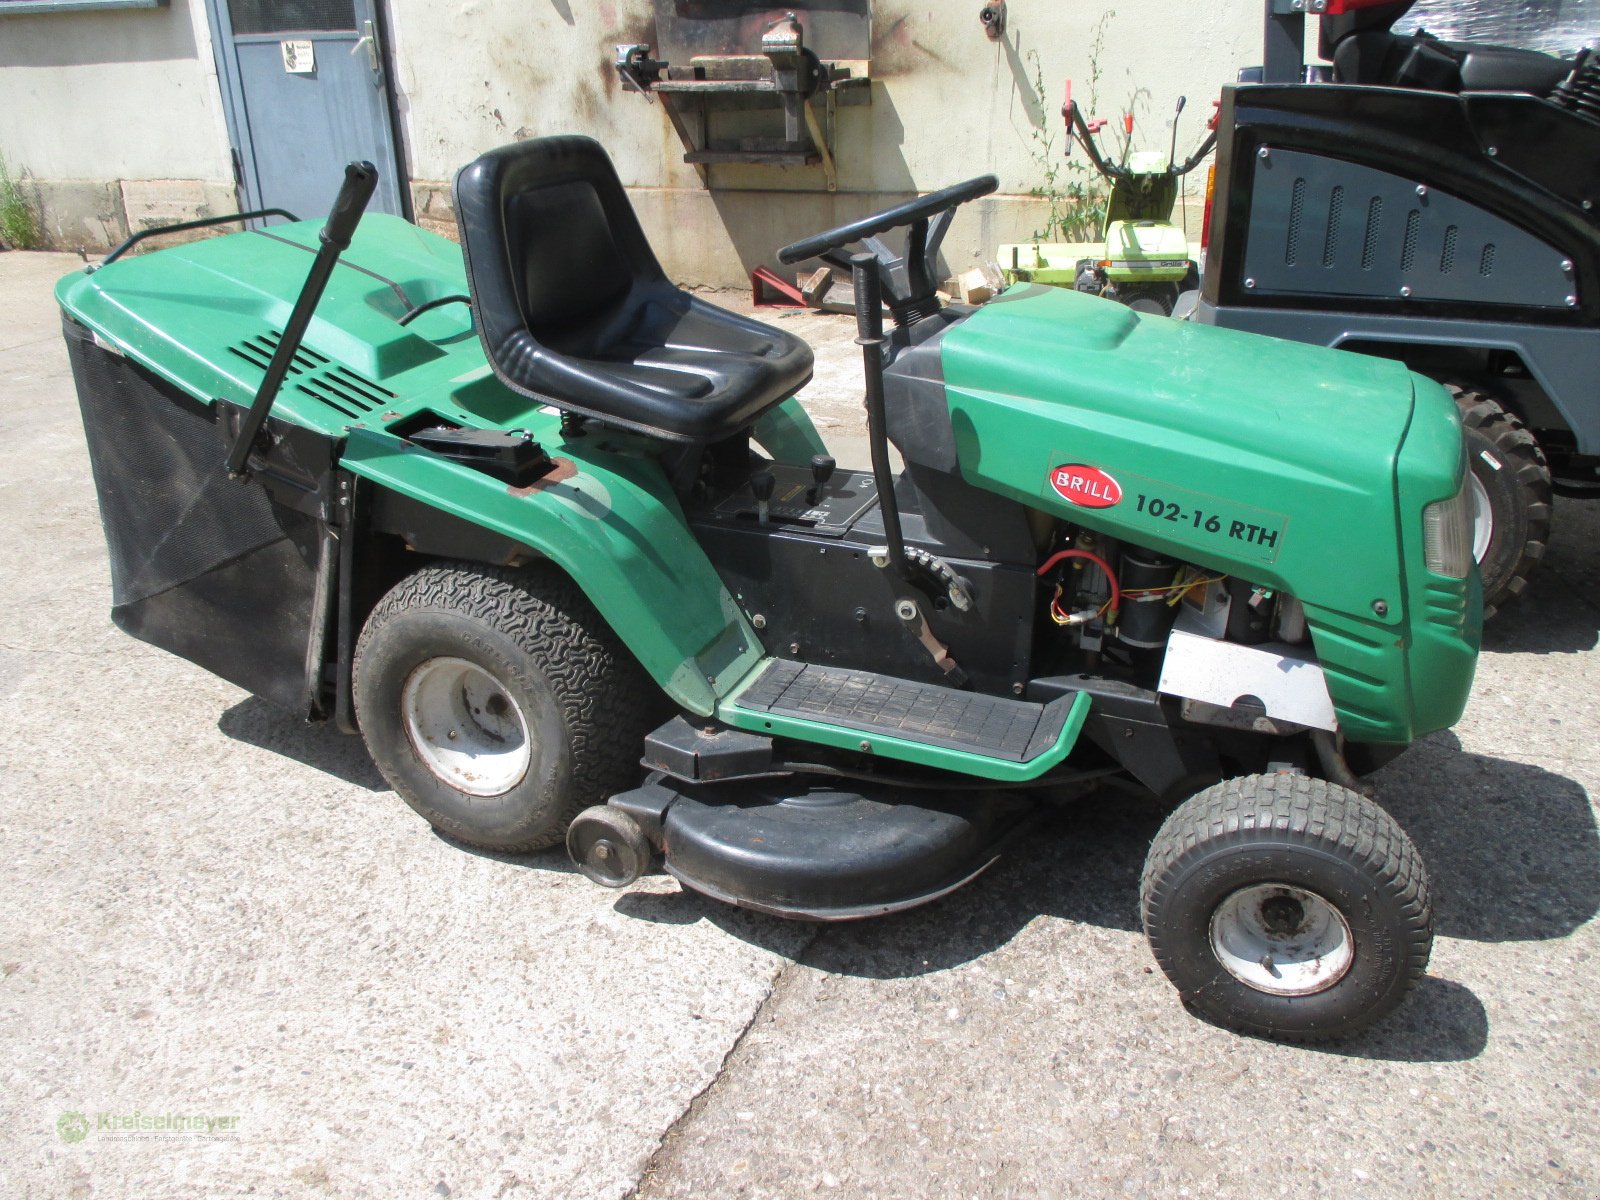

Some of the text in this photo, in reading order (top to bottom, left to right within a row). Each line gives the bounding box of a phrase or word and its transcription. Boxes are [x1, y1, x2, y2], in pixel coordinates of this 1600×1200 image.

[1056, 471, 1113, 502] BRILL
[1136, 494, 1278, 548] 102-16 RTH
